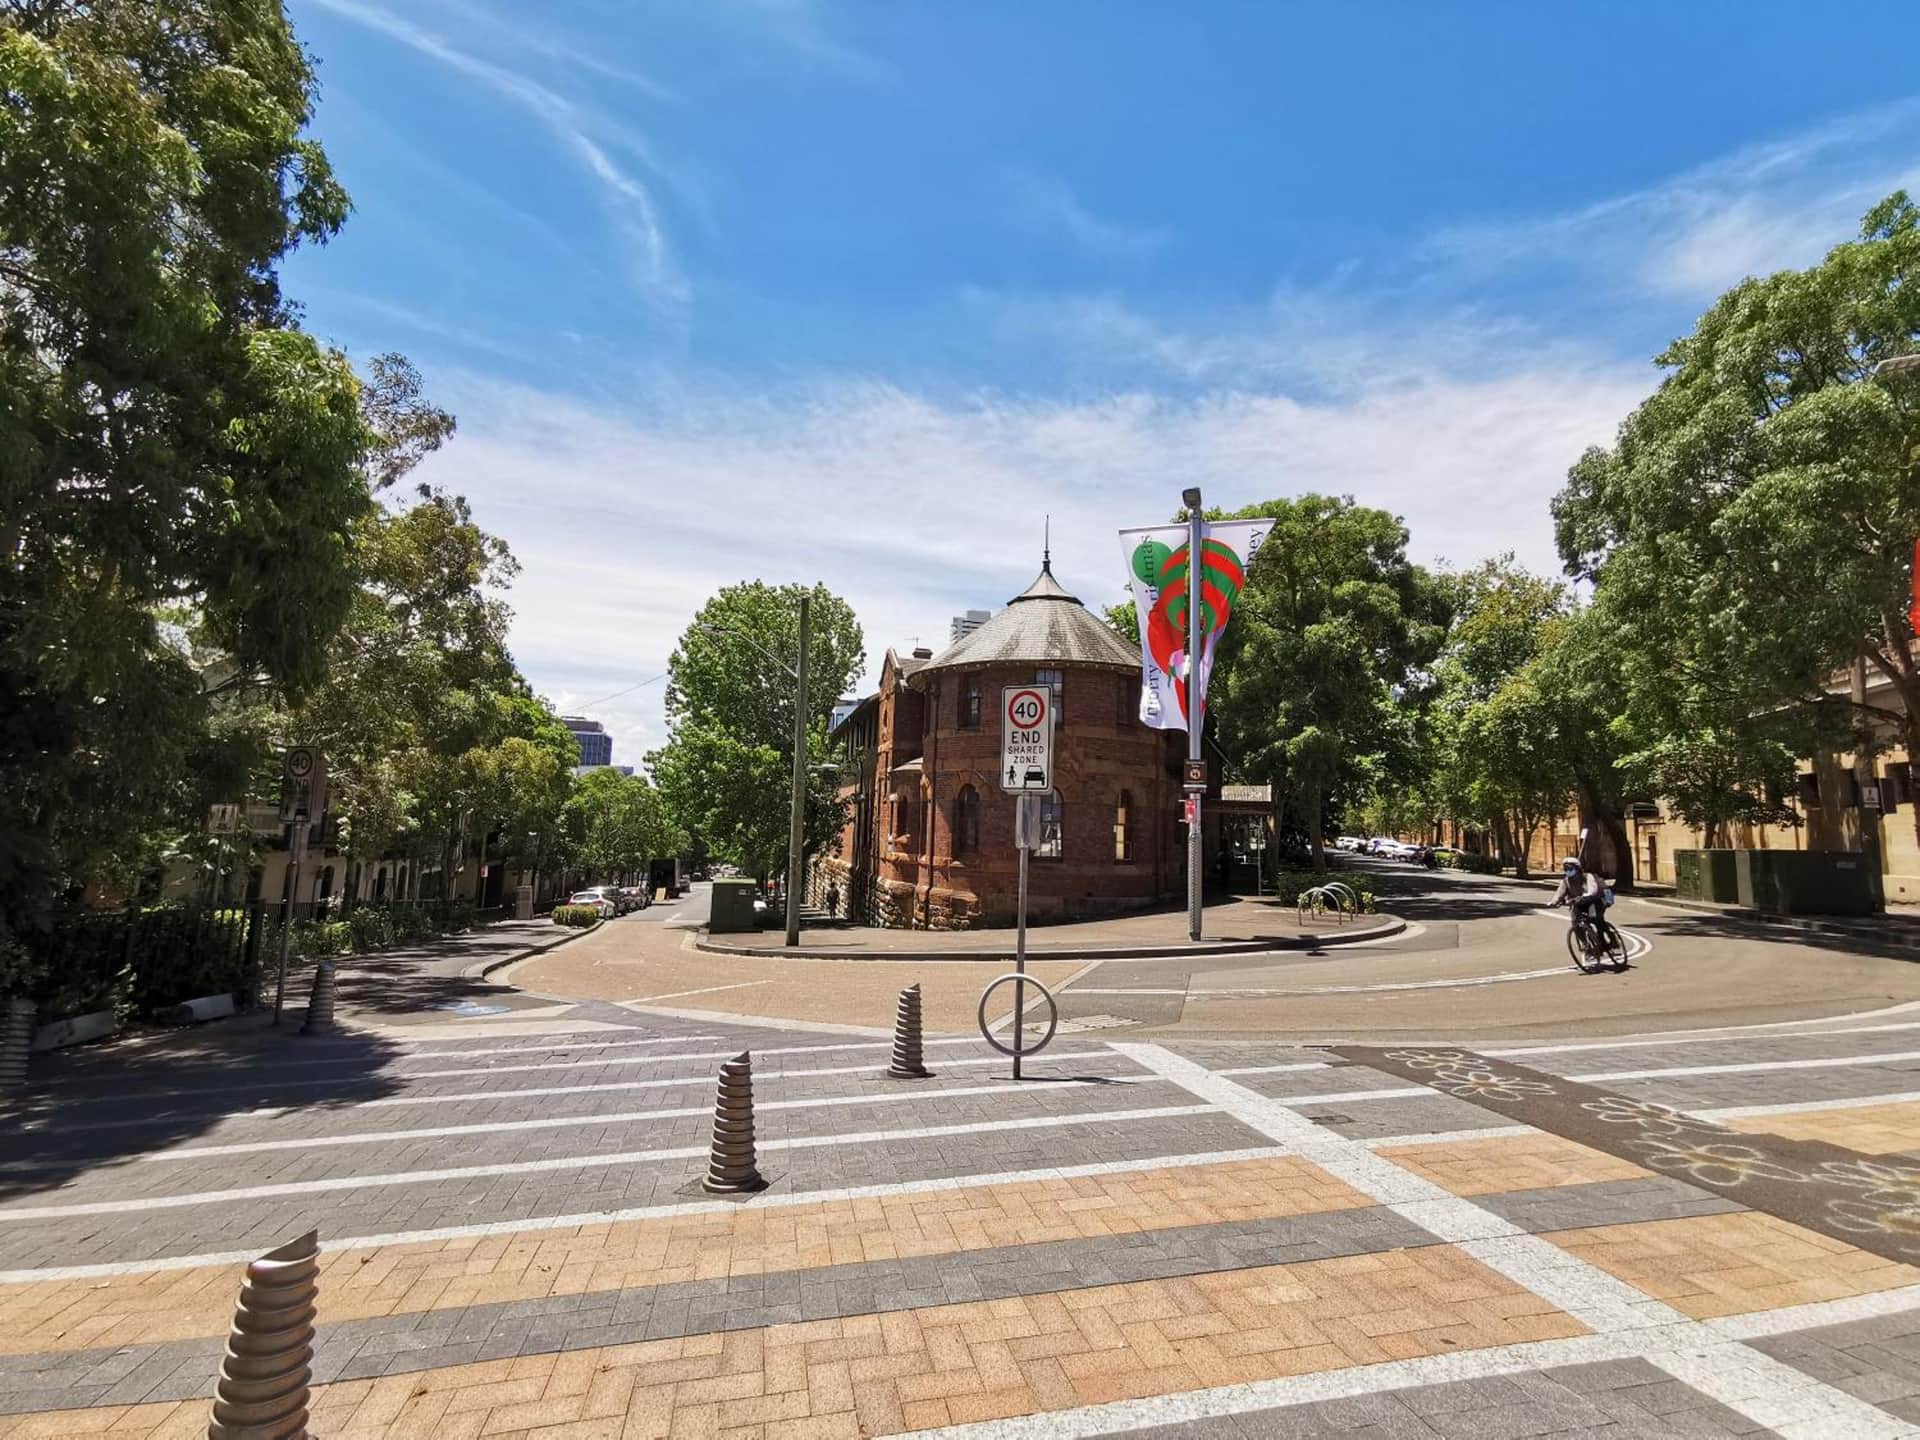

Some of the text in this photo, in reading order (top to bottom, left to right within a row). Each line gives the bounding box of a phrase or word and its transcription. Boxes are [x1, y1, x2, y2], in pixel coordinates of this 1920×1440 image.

[1141, 536, 1160, 615] hristmas
[1014, 701, 1038, 719] 40
[1011, 731, 1041, 744] END
[1007, 745, 1044, 755] SHARED
[293, 756, 308, 769] 40
[1013, 755, 1038, 764] ZONE
